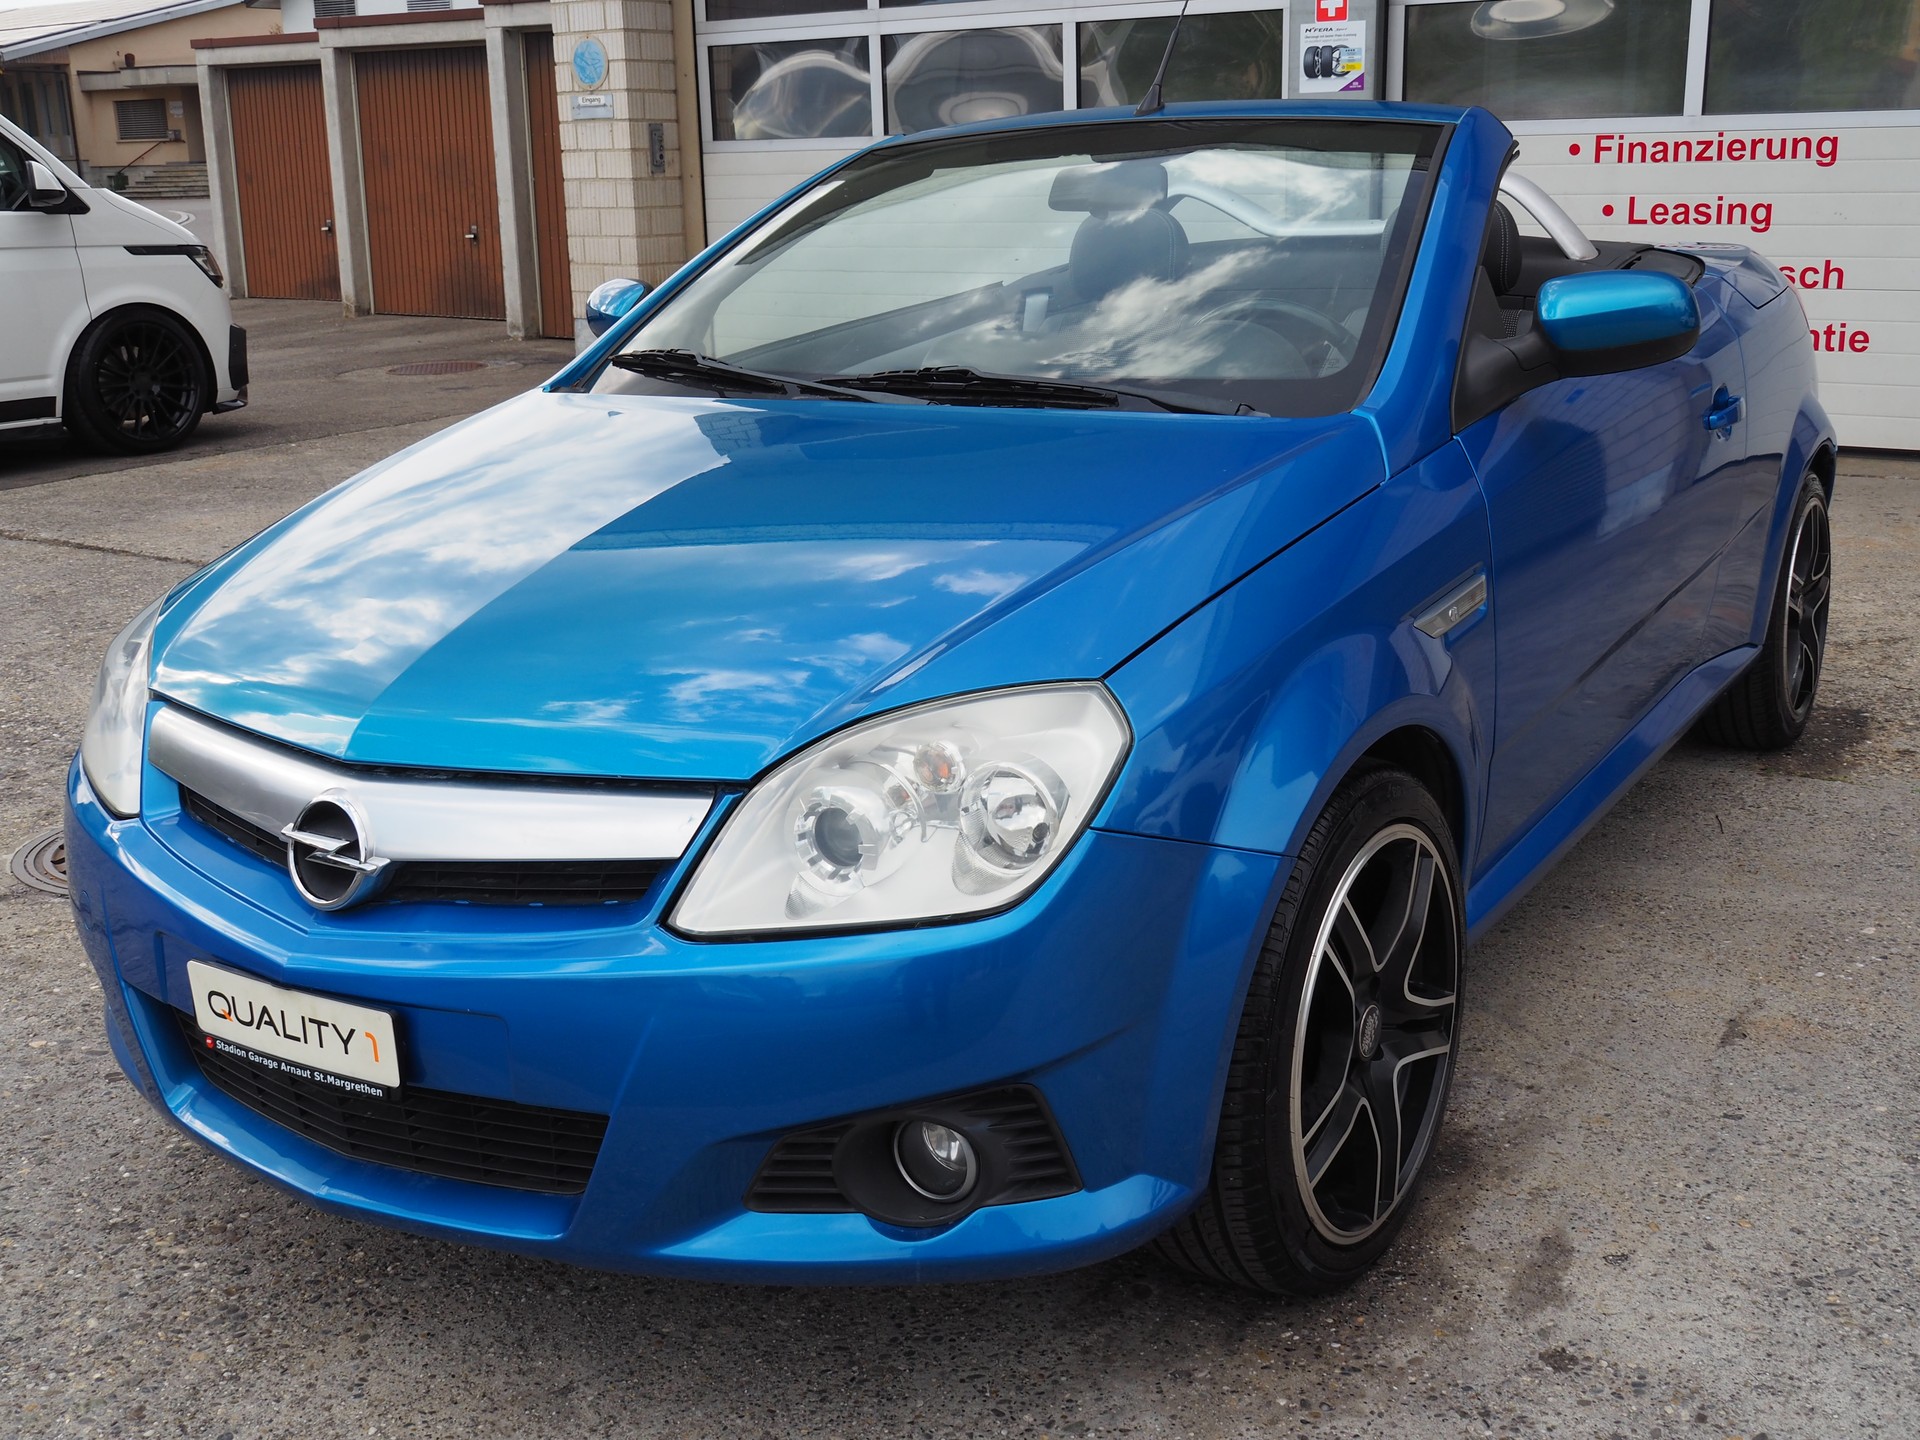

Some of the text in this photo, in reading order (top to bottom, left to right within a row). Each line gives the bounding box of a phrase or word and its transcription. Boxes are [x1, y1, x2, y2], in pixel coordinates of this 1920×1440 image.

[582, 96, 601, 104] Eingang
[1594, 131, 1839, 167] Finanzierung
[1628, 195, 1773, 233] Leasing
[207, 990, 380, 1063] QUALITY 1
[216, 1039, 383, 1098] Stadion Garage Arnaut St.Margrethen
